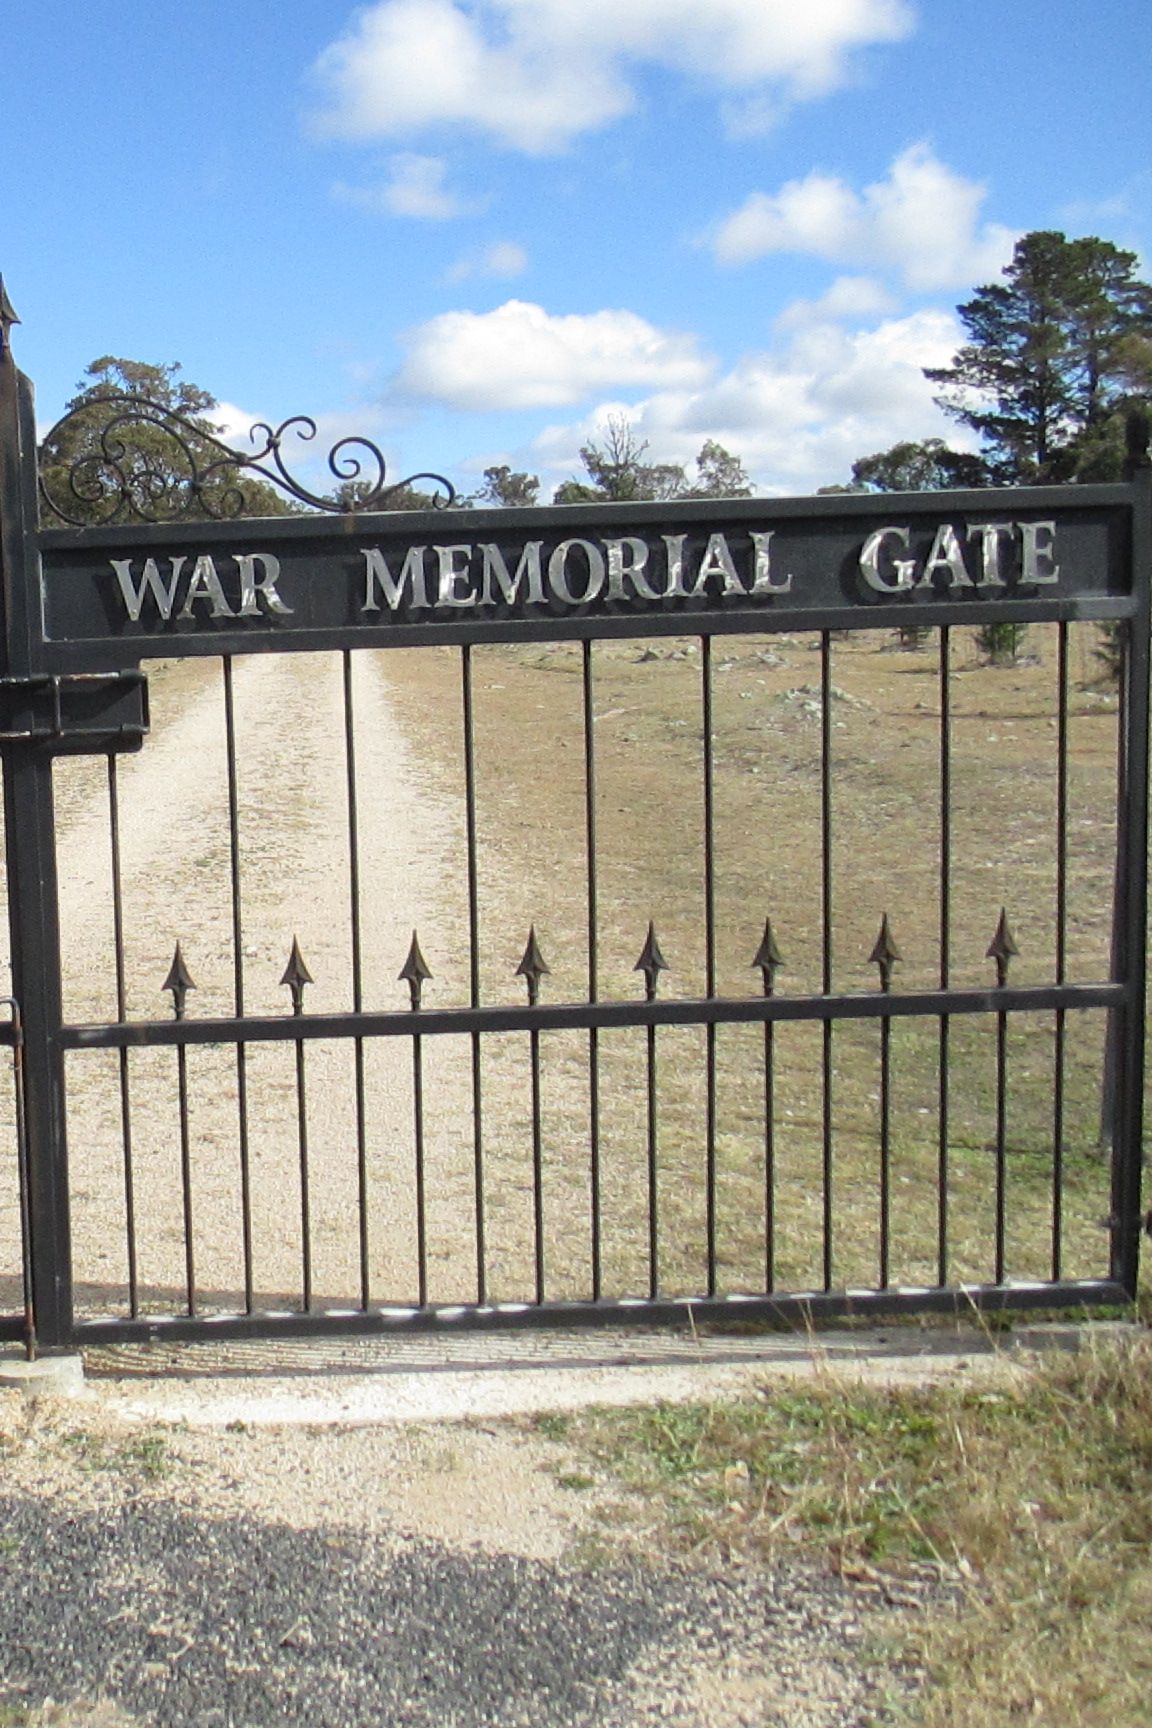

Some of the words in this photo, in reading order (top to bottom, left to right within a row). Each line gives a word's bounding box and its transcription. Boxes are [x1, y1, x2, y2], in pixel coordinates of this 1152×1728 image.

[109, 553, 294, 621] WAR
[359, 530, 792, 611] MEMORIAL
[859, 521, 1060, 593] GATE
